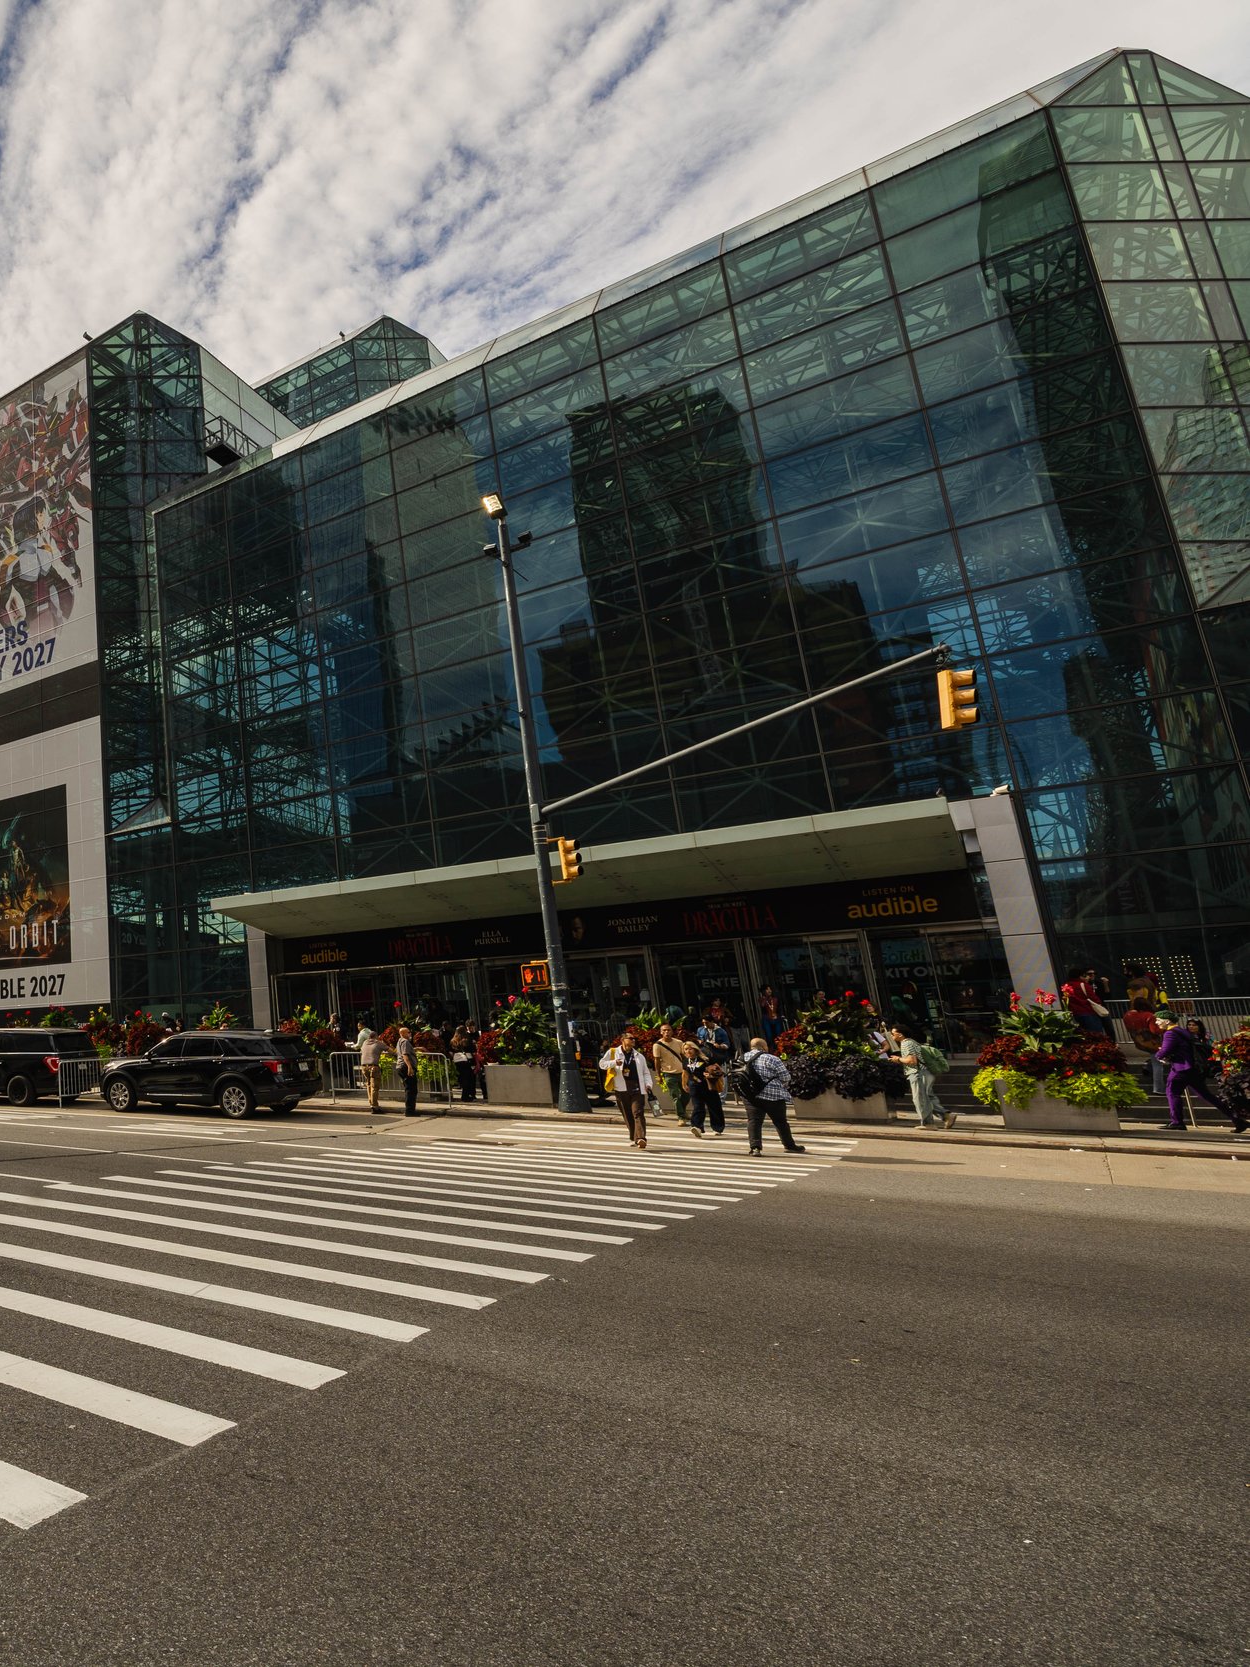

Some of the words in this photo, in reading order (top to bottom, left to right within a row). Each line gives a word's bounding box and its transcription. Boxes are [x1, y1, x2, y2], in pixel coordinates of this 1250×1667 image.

[12, 637, 56, 676] 2027
[862, 887, 896, 897] LISTEN
[900, 885, 915, 893] ON
[847, 895, 939, 918] audible
[607, 915, 658, 927] JONATHAN
[682, 904, 778, 937] DRACULA
[10, 920, 59, 950] ORBIT
[617, 923, 650, 934] BAILEY
[474, 936, 510, 946] PURNELL
[301, 948, 348, 965] audible
[913, 963, 963, 977] ONLY
[30, 974, 65, 998] 2027
[702, 976, 740, 989] ENTE
